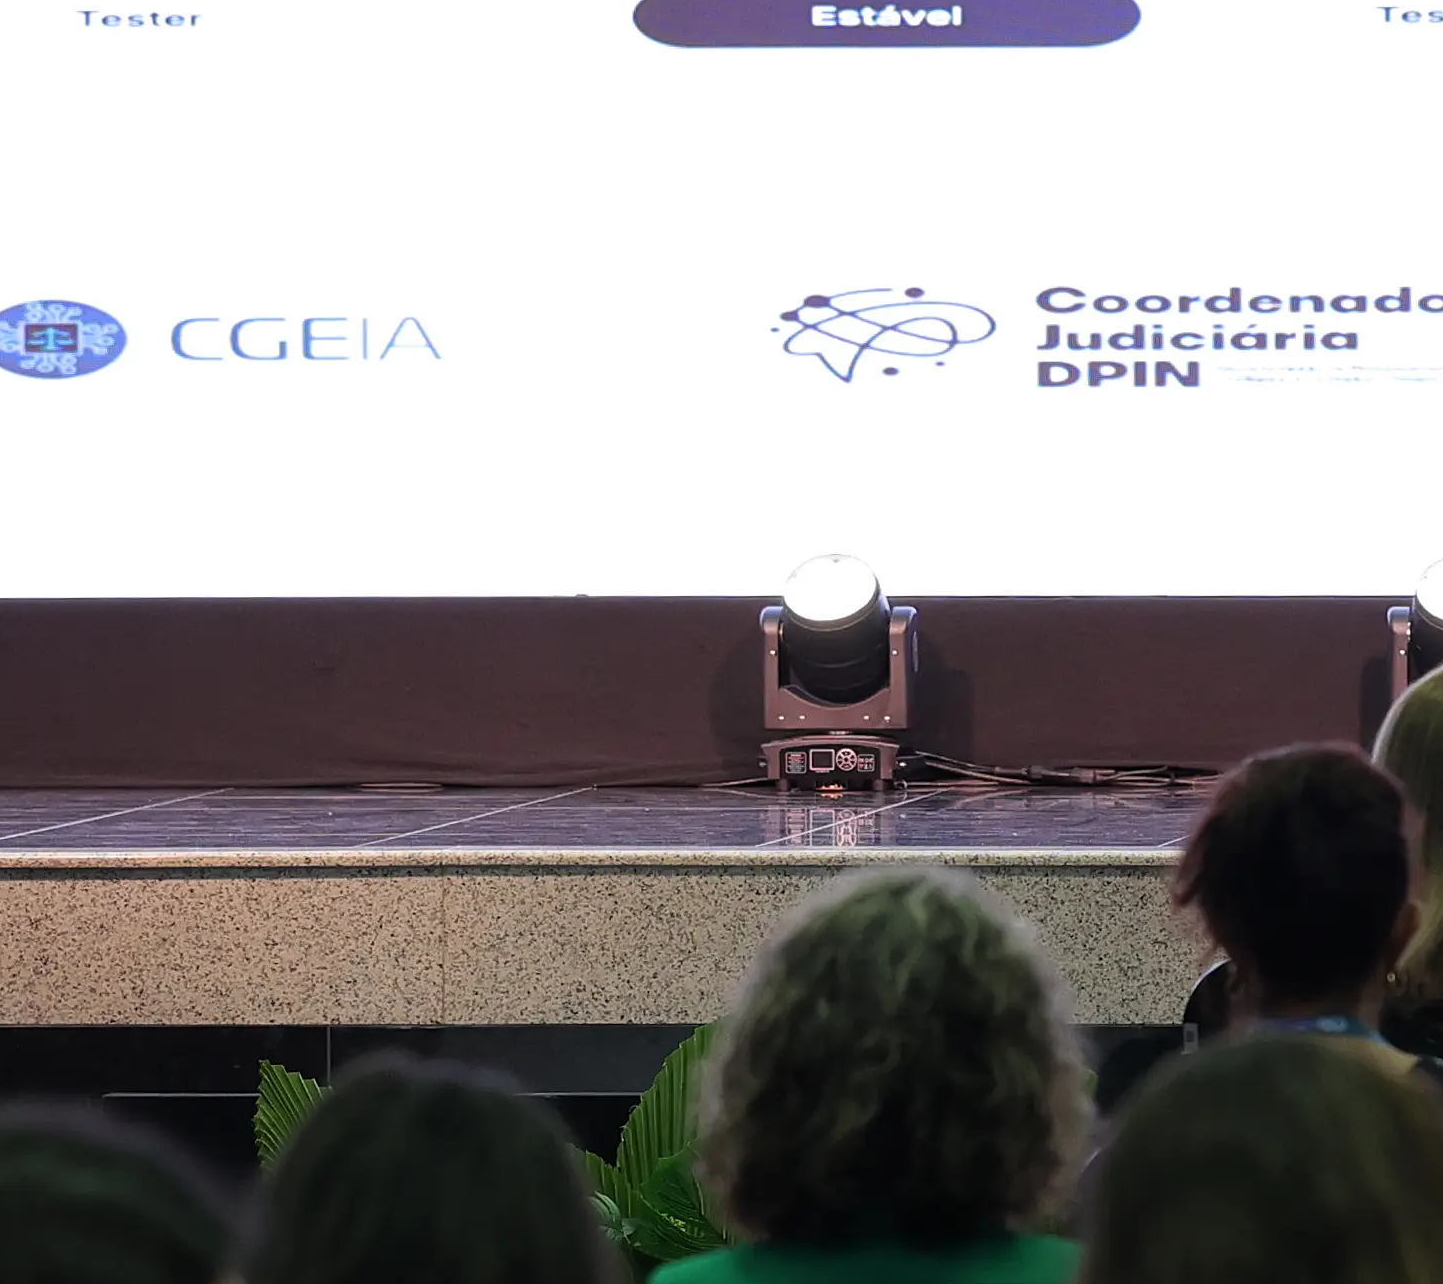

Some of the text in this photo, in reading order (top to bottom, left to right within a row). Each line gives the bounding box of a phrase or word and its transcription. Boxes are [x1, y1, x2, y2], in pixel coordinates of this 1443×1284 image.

[79, 11, 199, 27] Tester
[812, 4, 962, 26] Estável
[171, 317, 441, 360] CGEIA
[1037, 324, 1358, 351] Judiciária
[1037, 361, 1200, 387] DPIN
